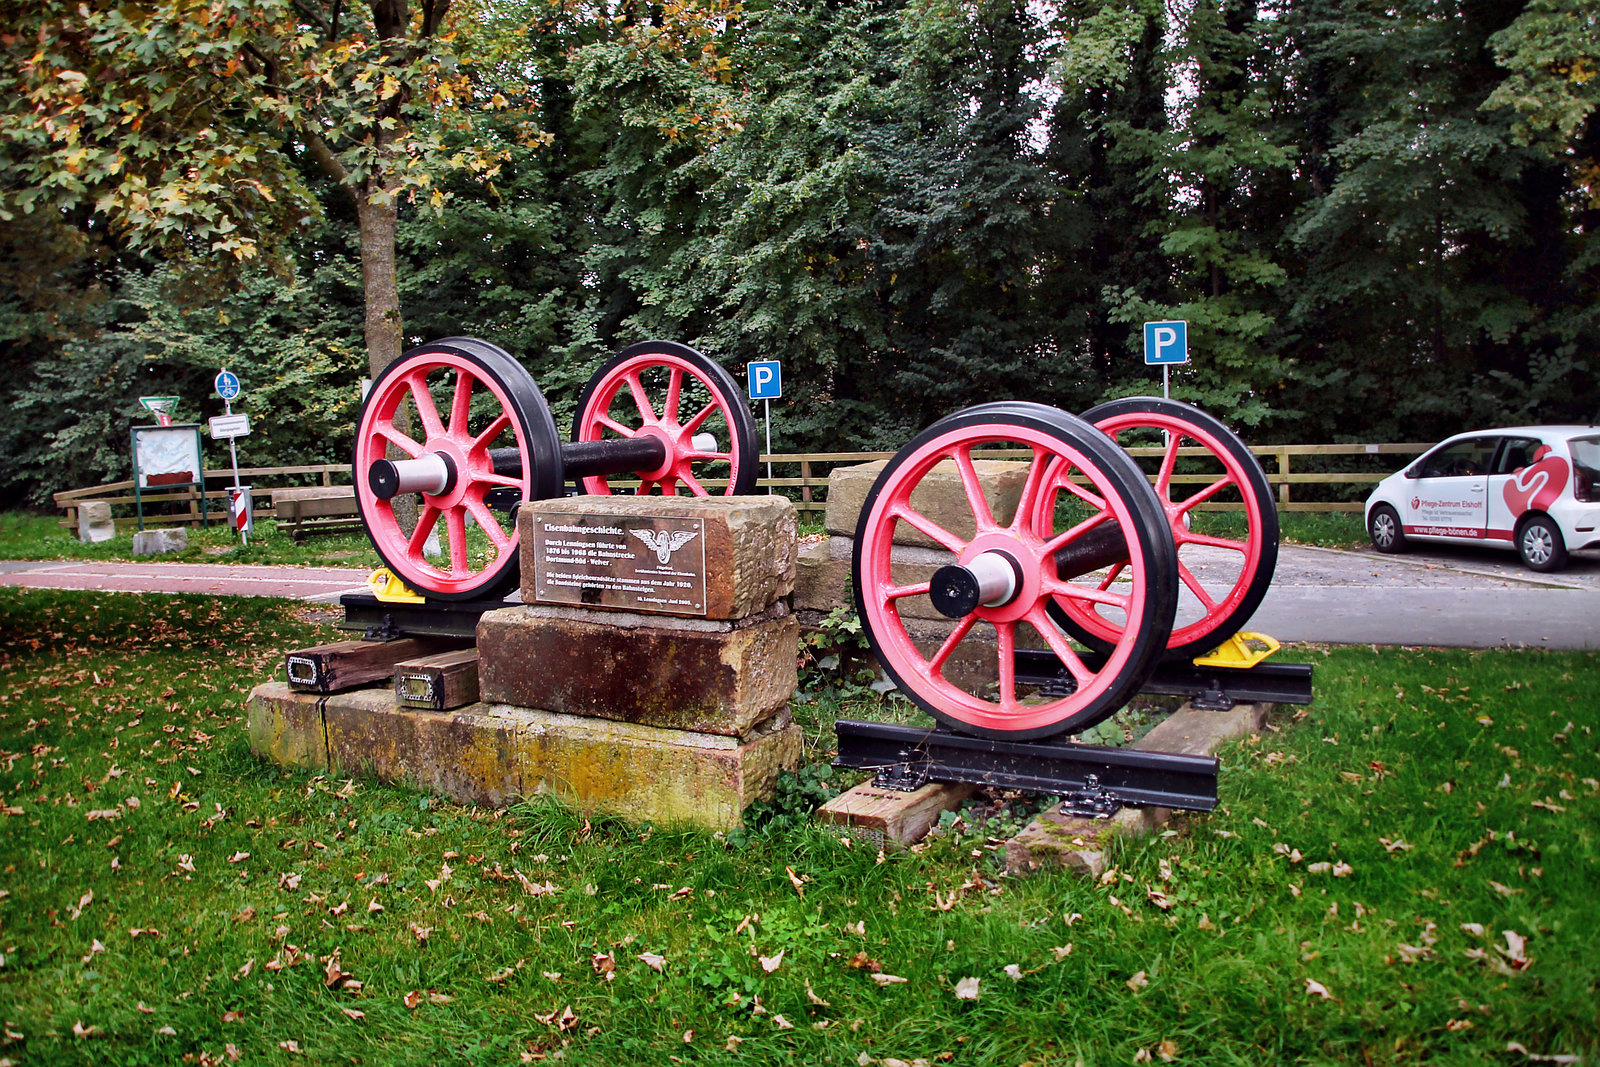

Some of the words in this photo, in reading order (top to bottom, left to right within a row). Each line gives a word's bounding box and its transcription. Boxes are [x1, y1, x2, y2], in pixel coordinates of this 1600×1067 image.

[1154, 327, 1177, 359] P
[755, 366, 773, 394] P
[1421, 500, 1460, 508] Pflege-Zentrum
[544, 524, 625, 535] Eisenbahngeschichte.
[1413, 526, 1478, 536] www.pflege-bönen.de
[563, 540, 595, 548] Lenningsen
[596, 542, 615, 550] führte
[545, 556, 586, 564] Dortmund-Süd
[598, 551, 636, 560] Bahnstrecke
[622, 585, 655, 593] Bahnsteigen.
